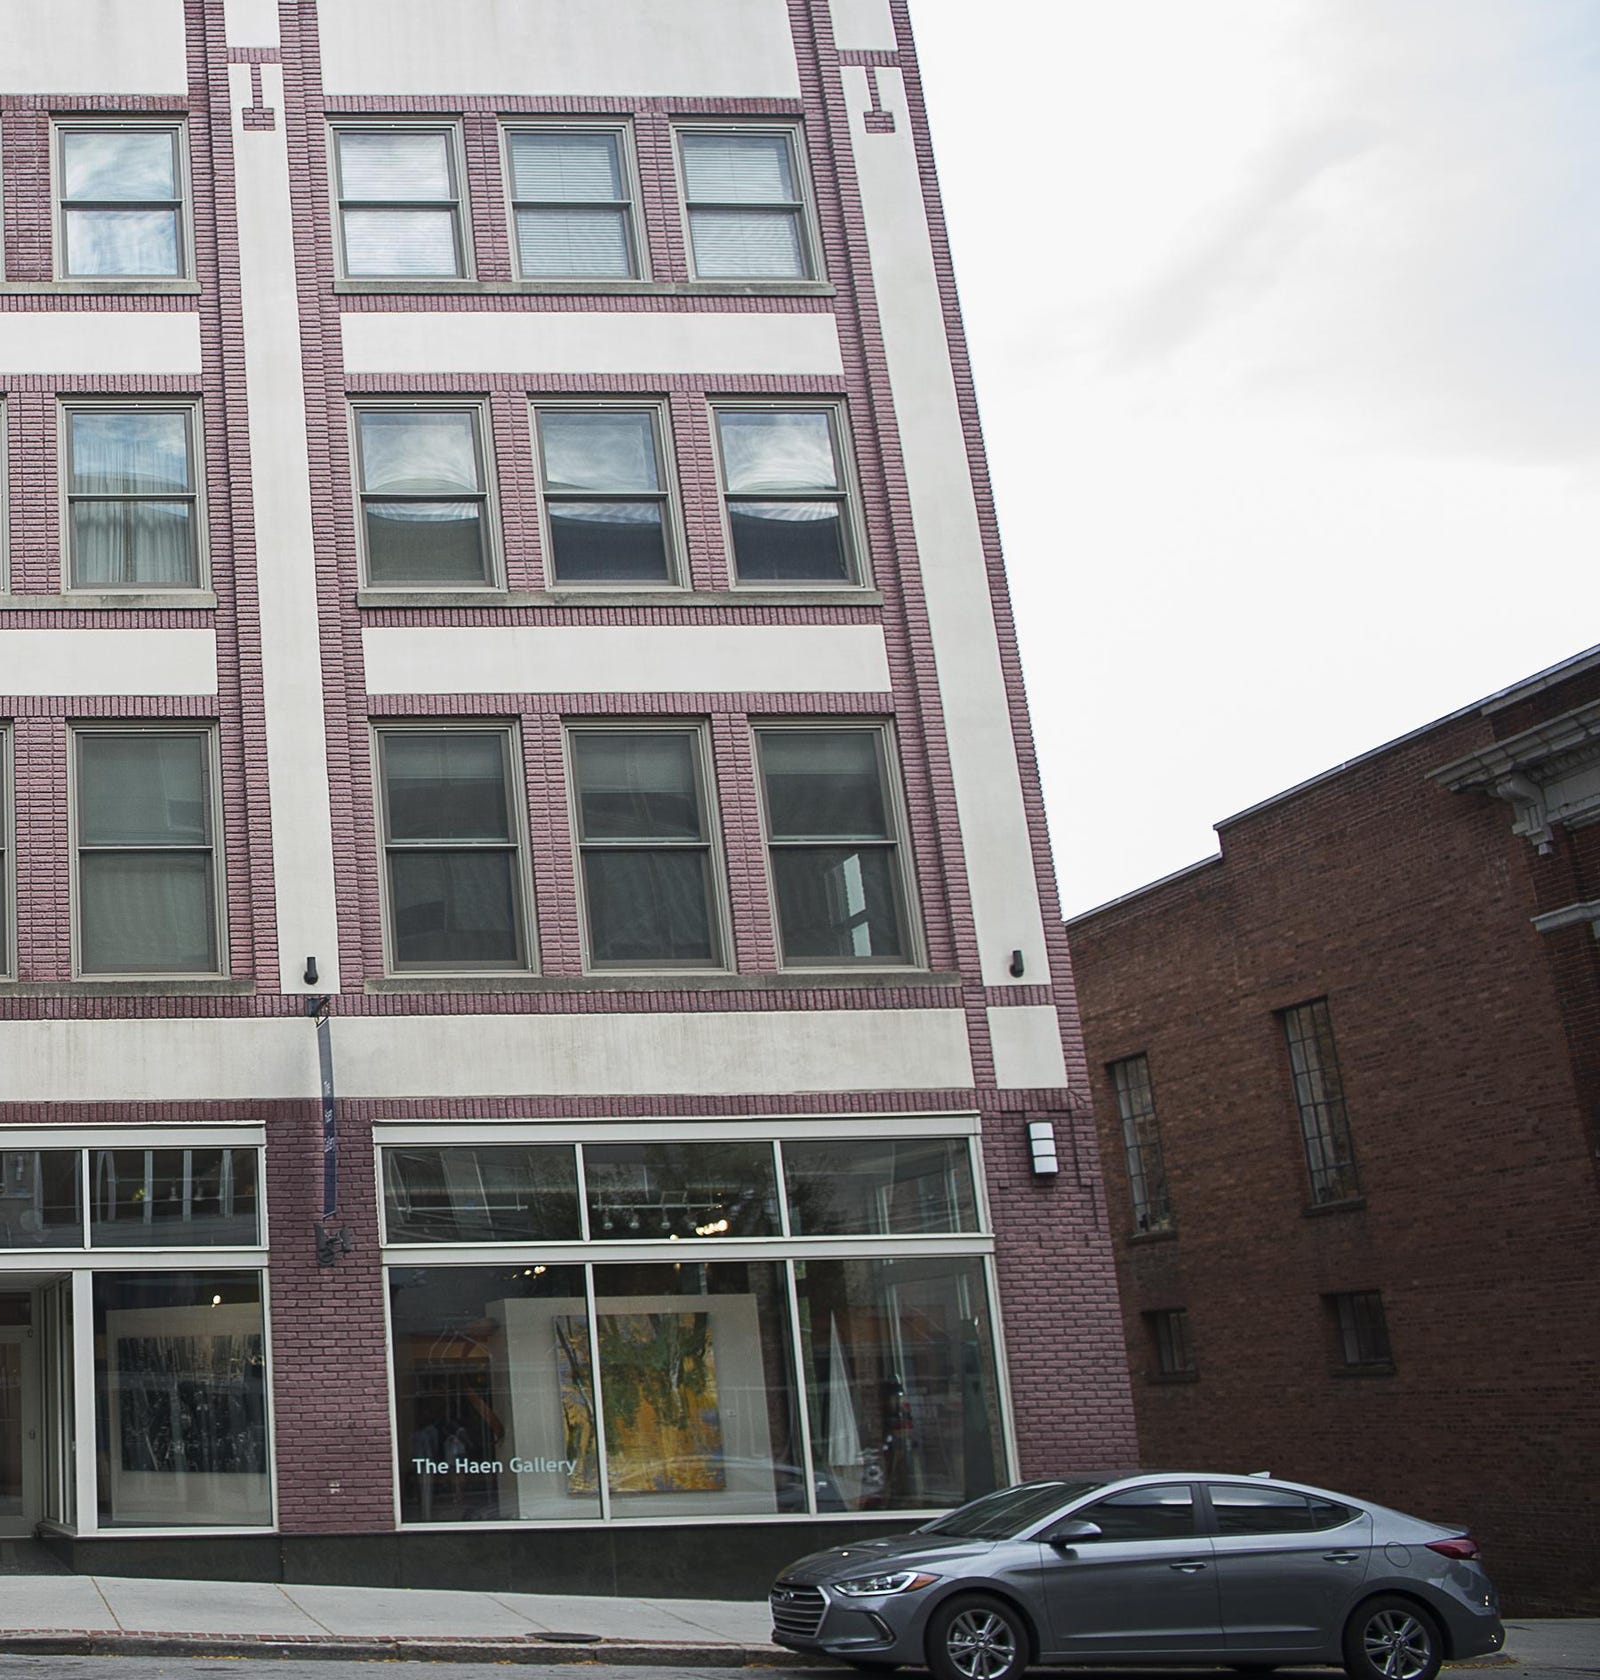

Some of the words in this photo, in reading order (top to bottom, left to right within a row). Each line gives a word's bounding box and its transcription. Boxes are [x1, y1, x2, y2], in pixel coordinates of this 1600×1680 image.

[411, 1458, 449, 1475] The
[455, 1458, 504, 1474] Haen
[509, 1457, 578, 1476] Gallery
